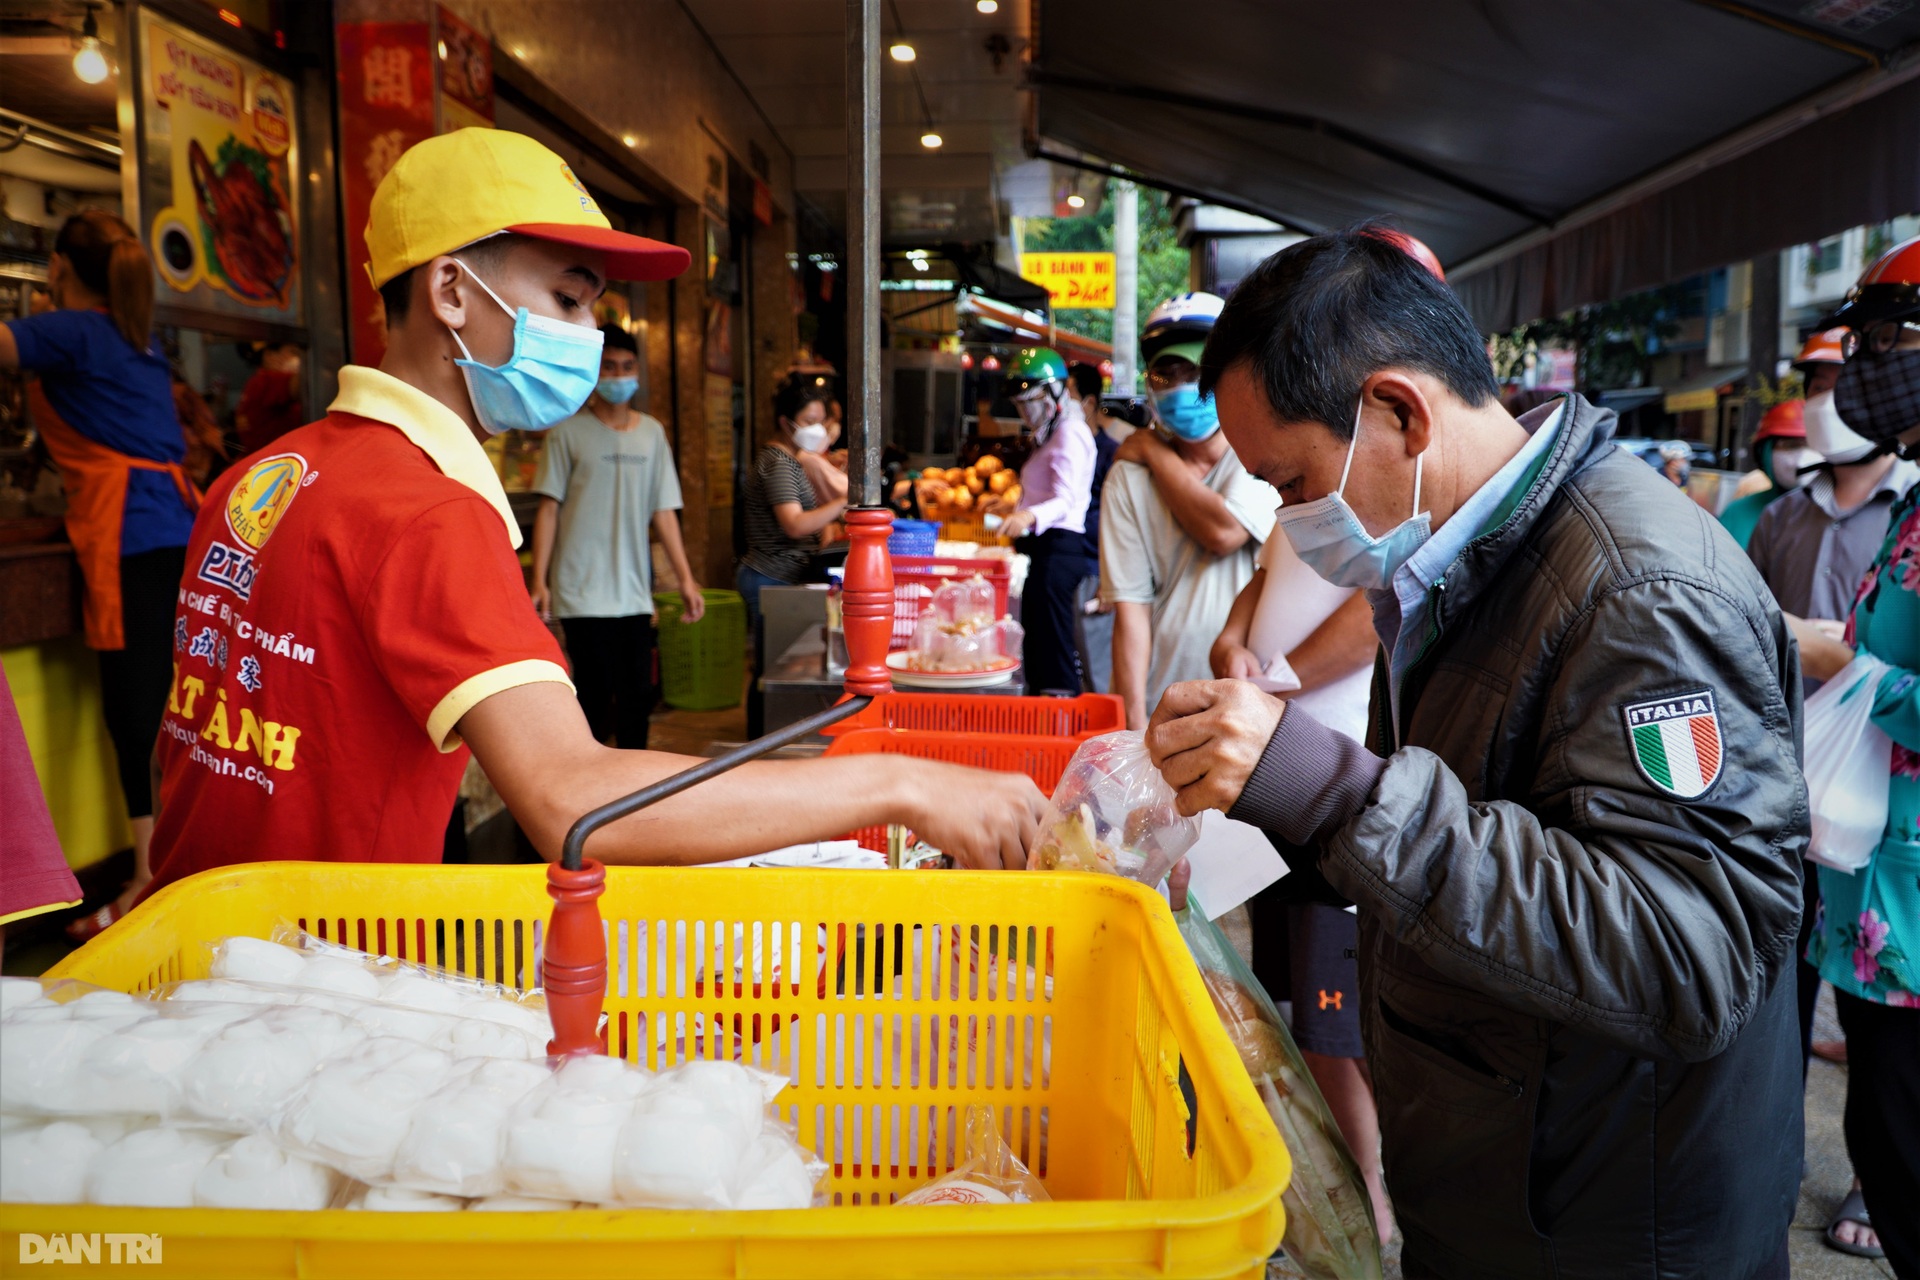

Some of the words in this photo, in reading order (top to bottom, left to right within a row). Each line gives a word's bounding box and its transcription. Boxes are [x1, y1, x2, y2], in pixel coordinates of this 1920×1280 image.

[187, 591, 221, 616] CHẾ
[254, 627, 316, 665] PHẨM
[1631, 699, 1709, 724] ITALIA
